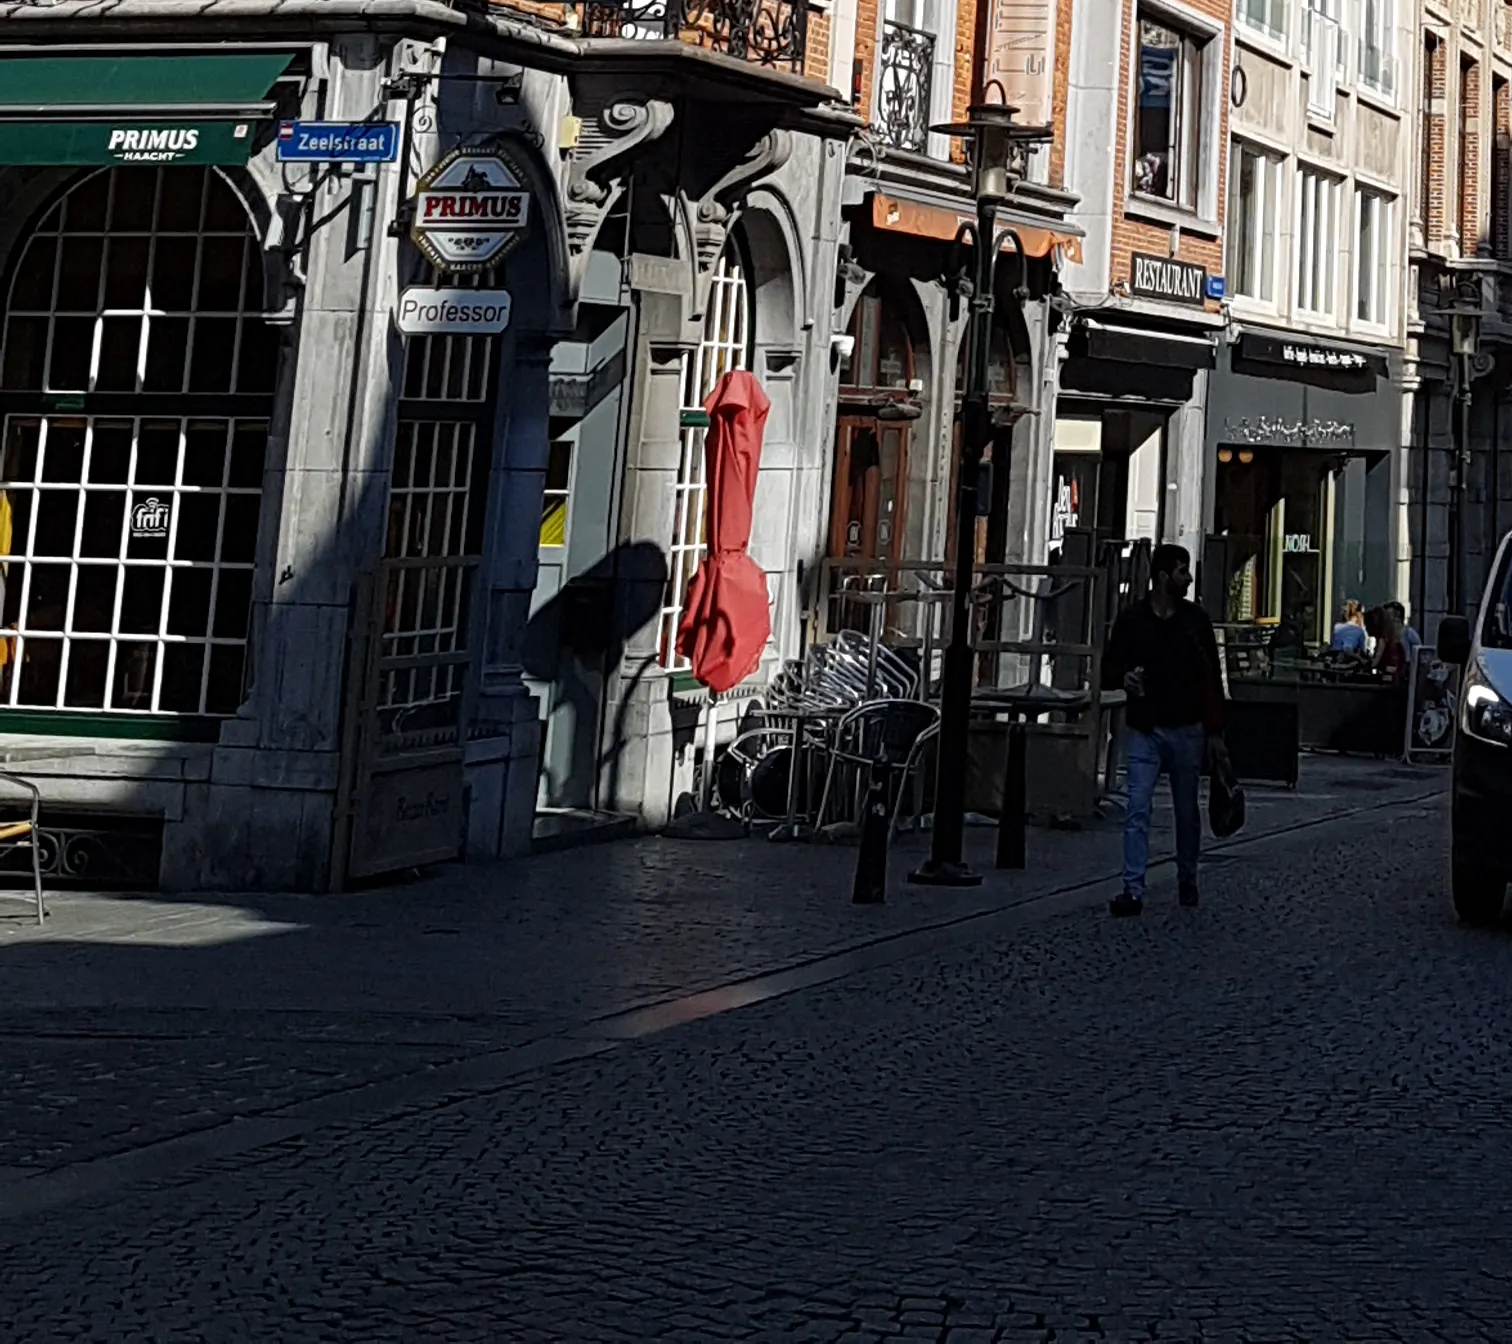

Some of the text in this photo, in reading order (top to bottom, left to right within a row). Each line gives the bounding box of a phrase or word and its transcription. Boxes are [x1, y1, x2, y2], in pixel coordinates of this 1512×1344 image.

[108, 129, 199, 150] PRIMUS
[298, 133, 385, 152] Zeelstraat
[123, 152, 177, 161] HAACHT
[423, 196, 522, 218] PRIMUS
[1134, 257, 1203, 299] RESTAURANT
[402, 299, 507, 323] Professor
